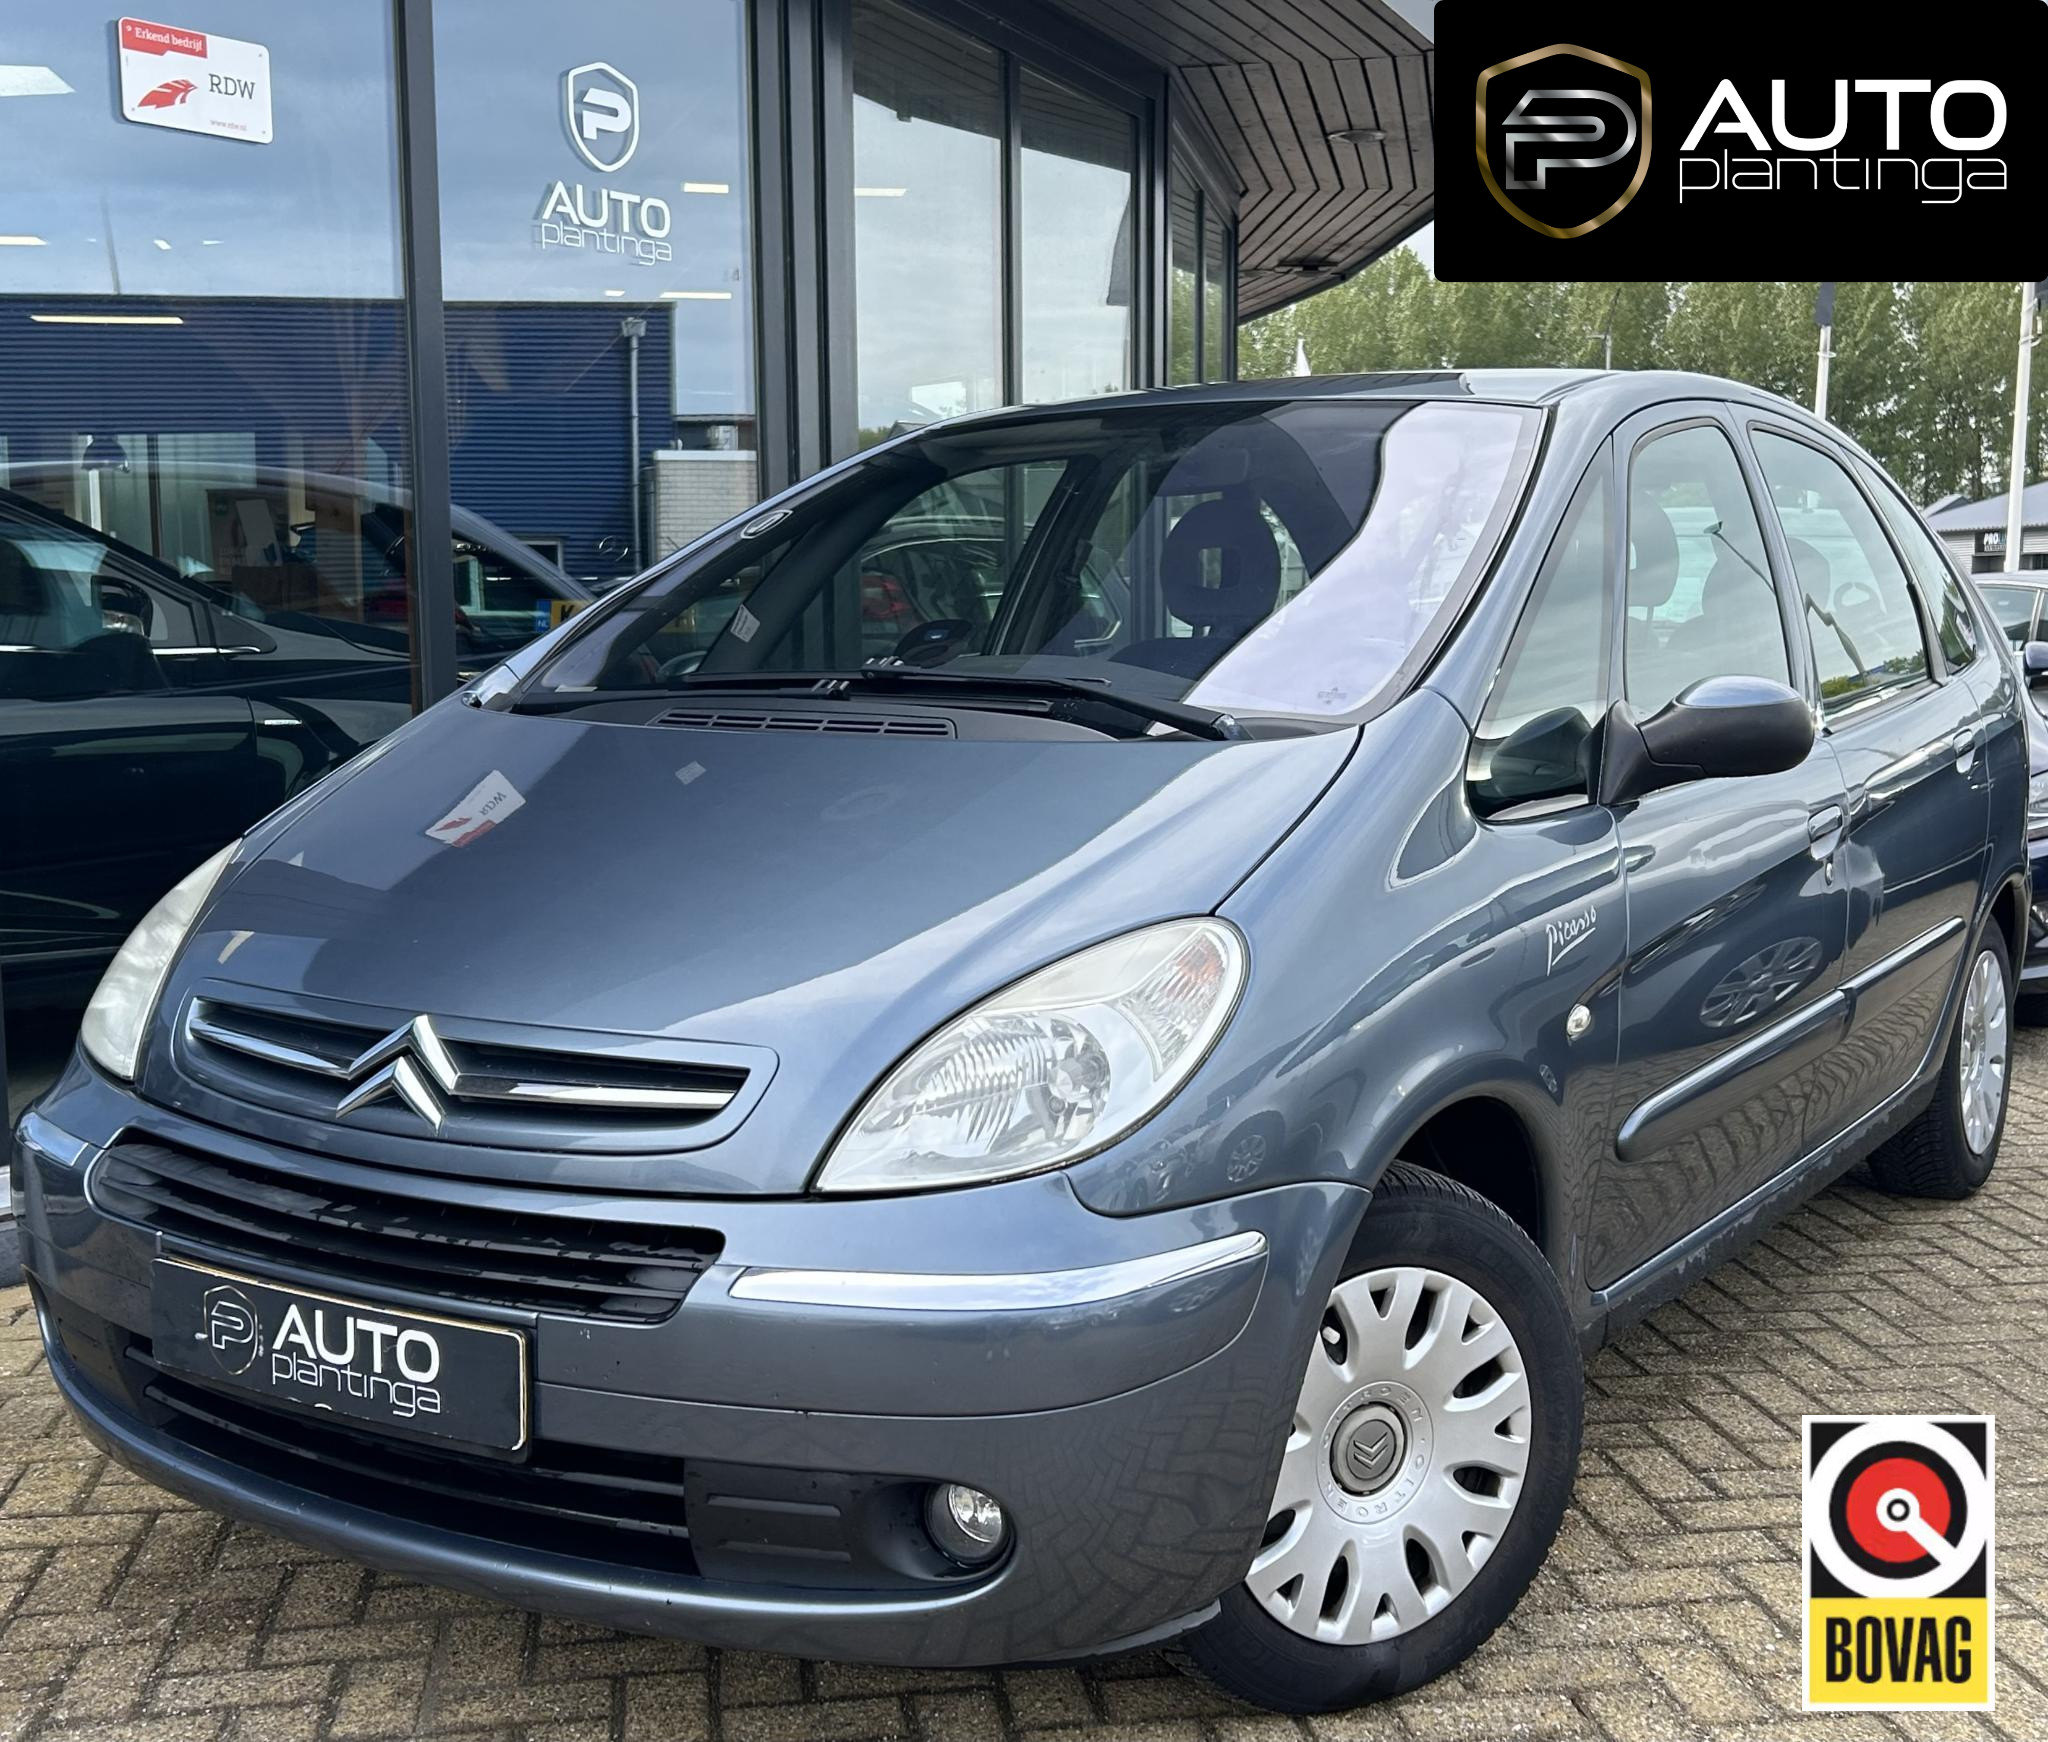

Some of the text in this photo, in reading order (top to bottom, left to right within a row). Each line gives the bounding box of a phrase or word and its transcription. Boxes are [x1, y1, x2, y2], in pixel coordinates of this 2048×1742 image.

[134, 26, 203, 52] Erkend bedrijf
[208, 73, 256, 100] RDW
[542, 180, 671, 239] AUTO
[541, 220, 672, 266] plantinga
[1545, 904, 1598, 977] Picasso
[271, 1303, 441, 1384] AUTO
[271, 1352, 441, 1418] plantinga
